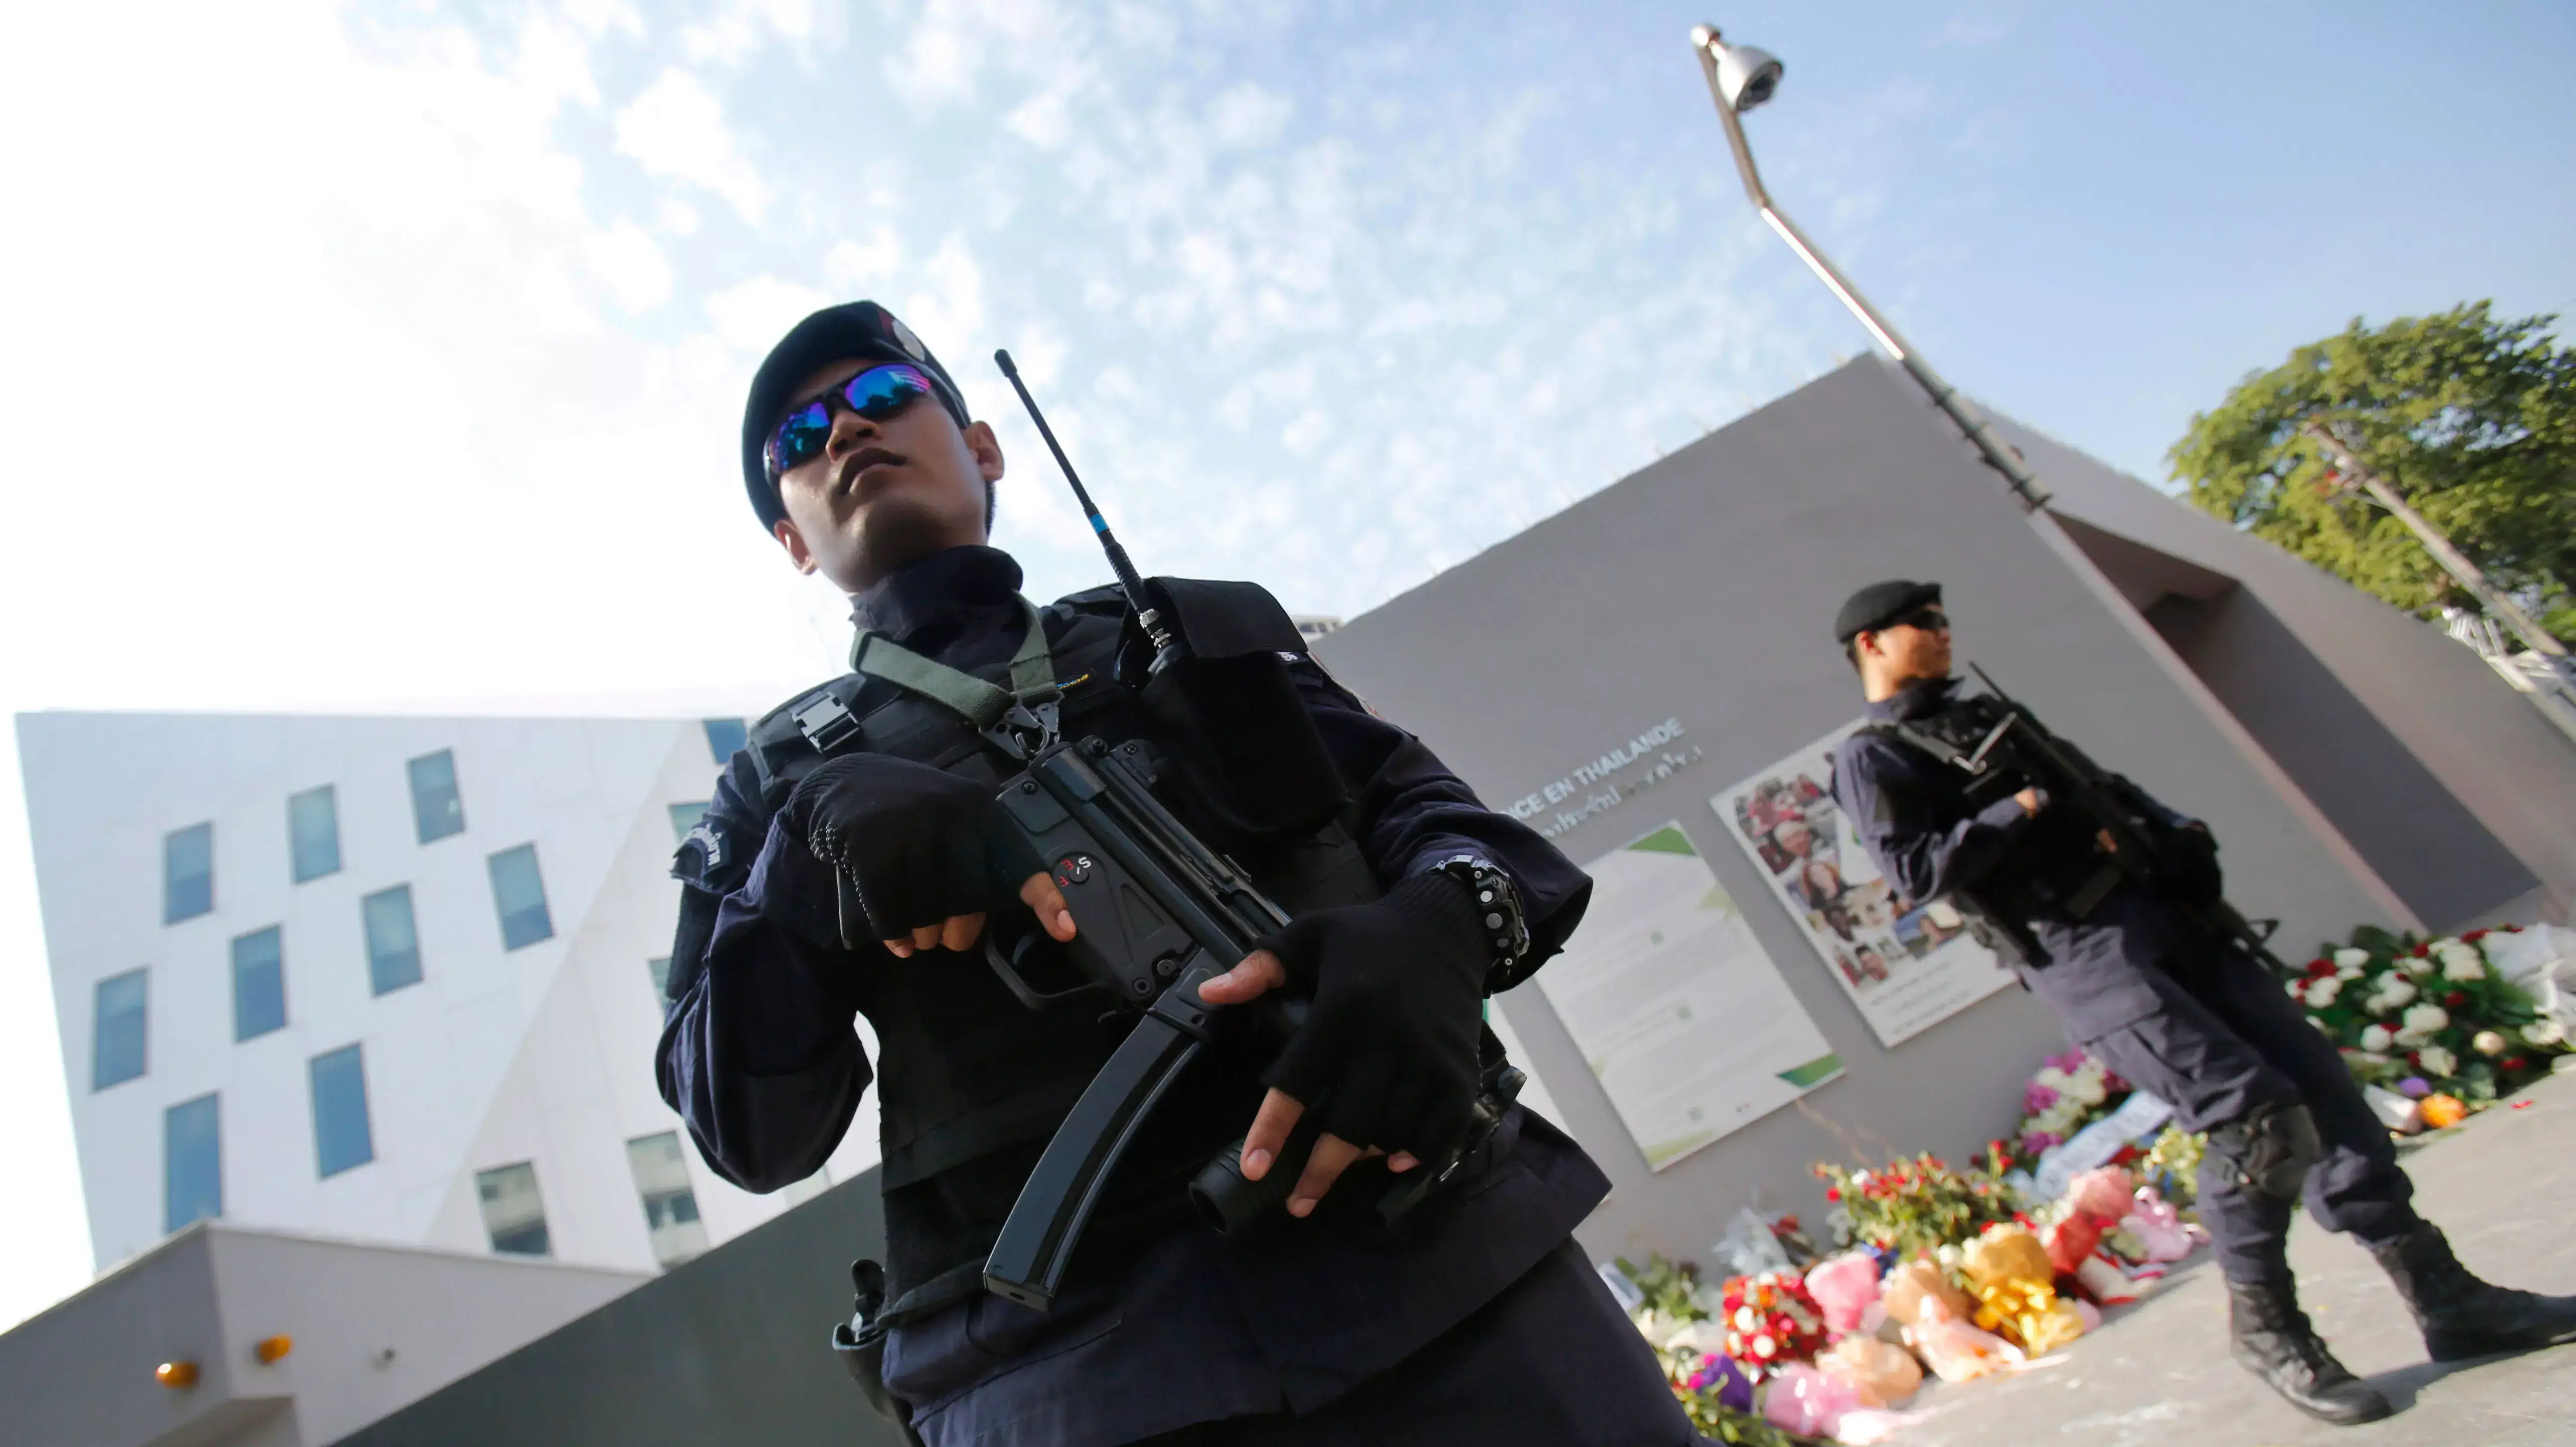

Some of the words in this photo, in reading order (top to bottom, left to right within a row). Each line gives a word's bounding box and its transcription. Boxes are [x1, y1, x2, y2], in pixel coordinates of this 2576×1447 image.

[1543, 777, 1575, 804] EN
[1573, 717, 1685, 786] THAILANDE
[1078, 856, 1092, 869] S
